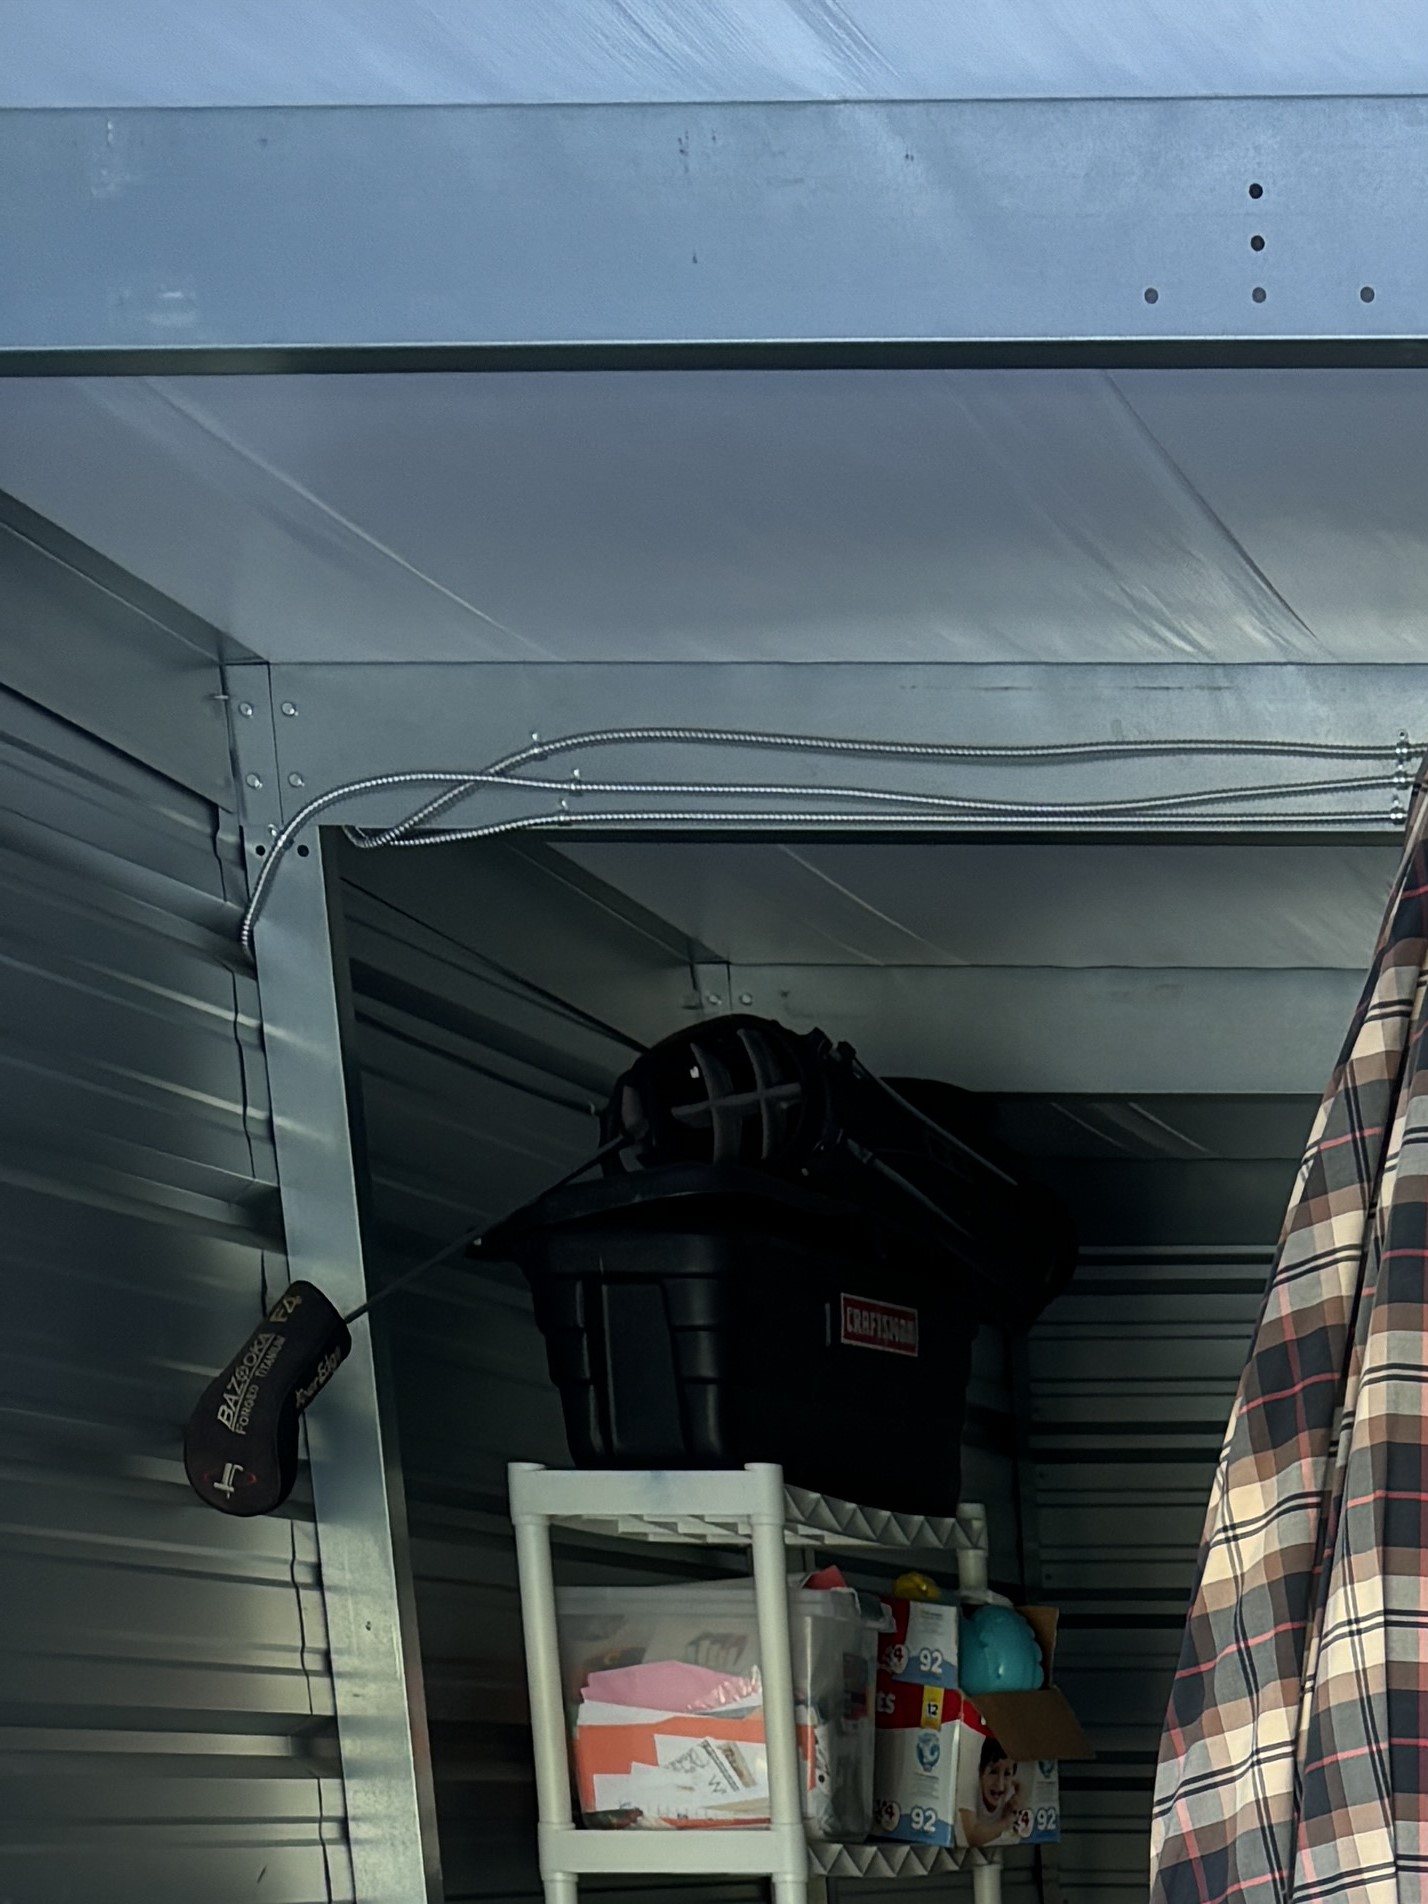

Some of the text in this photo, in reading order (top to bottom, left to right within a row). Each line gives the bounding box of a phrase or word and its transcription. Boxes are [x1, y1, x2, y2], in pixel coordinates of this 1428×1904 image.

[920, 1648, 943, 1674] 92
[911, 1806, 936, 1832] 92
[1037, 1808, 1056, 1830] 92
